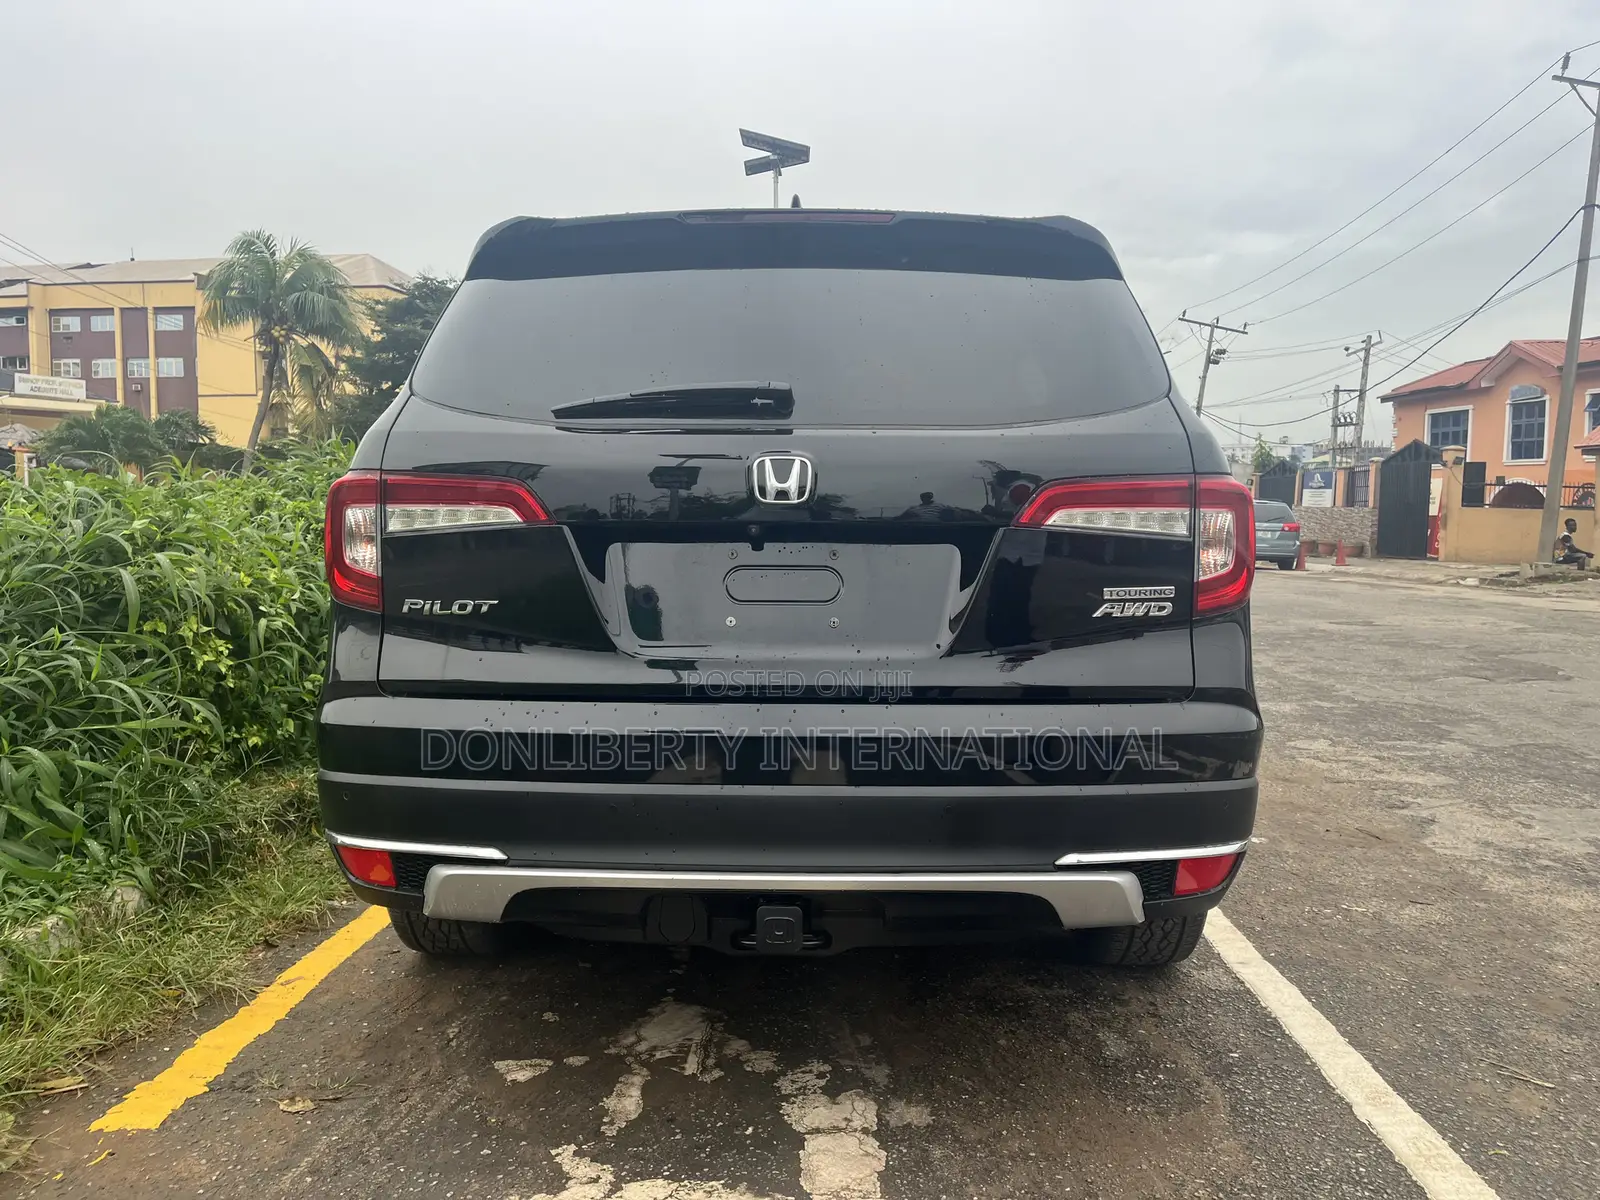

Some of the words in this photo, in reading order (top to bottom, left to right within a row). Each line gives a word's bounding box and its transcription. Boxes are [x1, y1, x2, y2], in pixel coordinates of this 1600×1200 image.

[1107, 588, 1174, 598] TOURING
[401, 599, 499, 616] PILOT
[1092, 602, 1173, 617] AWD
